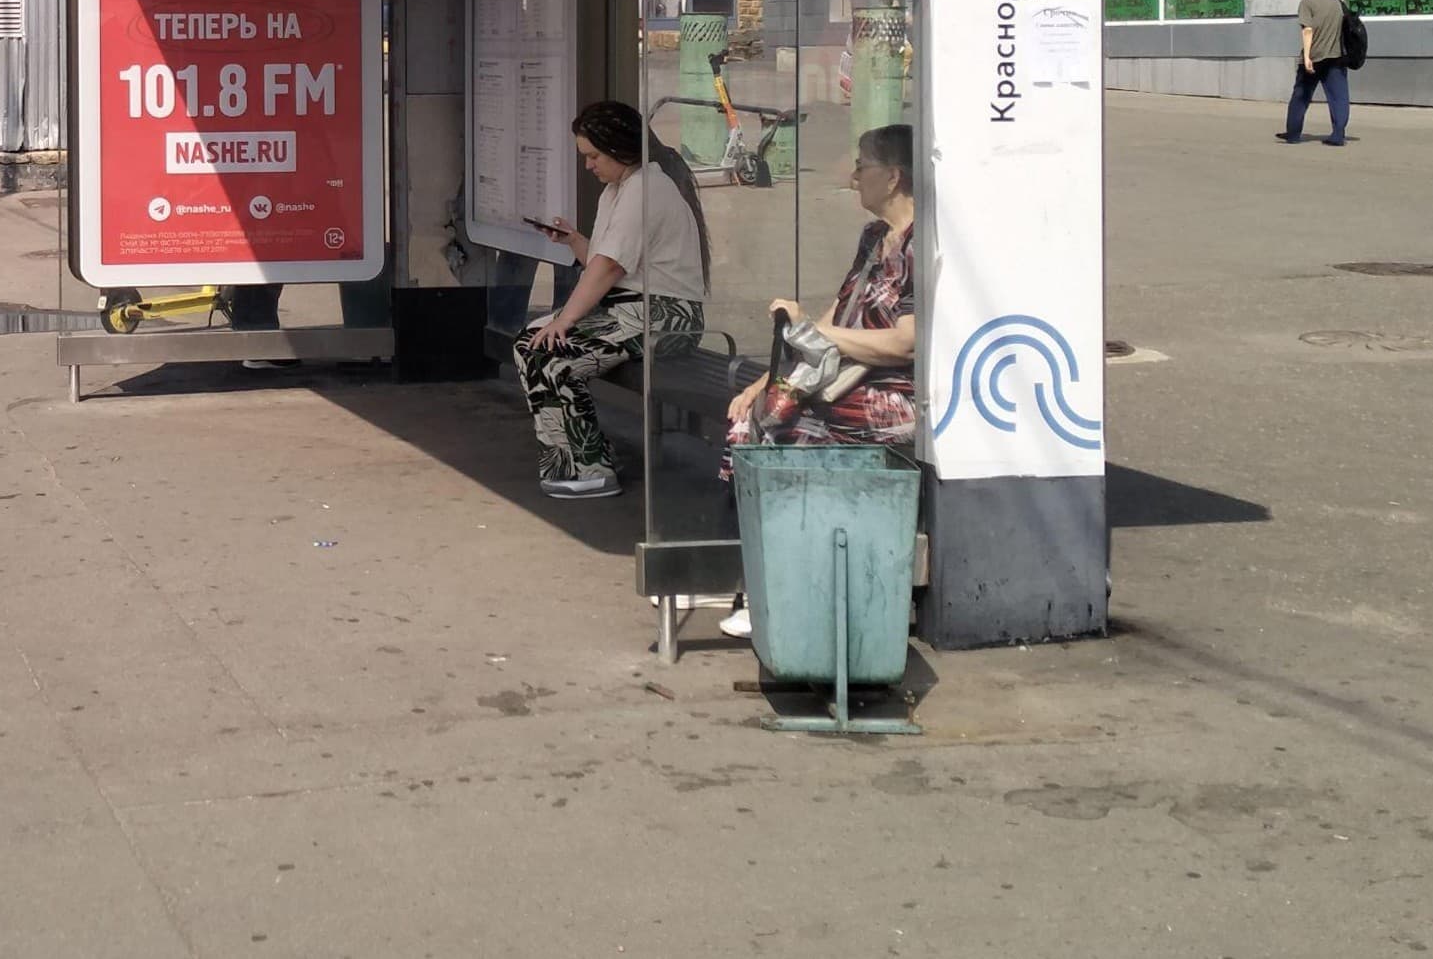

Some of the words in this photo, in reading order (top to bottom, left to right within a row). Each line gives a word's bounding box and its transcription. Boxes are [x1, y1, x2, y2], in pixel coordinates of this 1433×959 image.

[154, 13, 256, 40] ТЕПЕРЬ
[267, 14, 302, 39] НА
[119, 64, 247, 118] 101.8
[175, 141, 288, 164] NASHE.RU
[175, 203, 232, 215] @nashe_ru
[276, 202, 315, 213] @nashe
